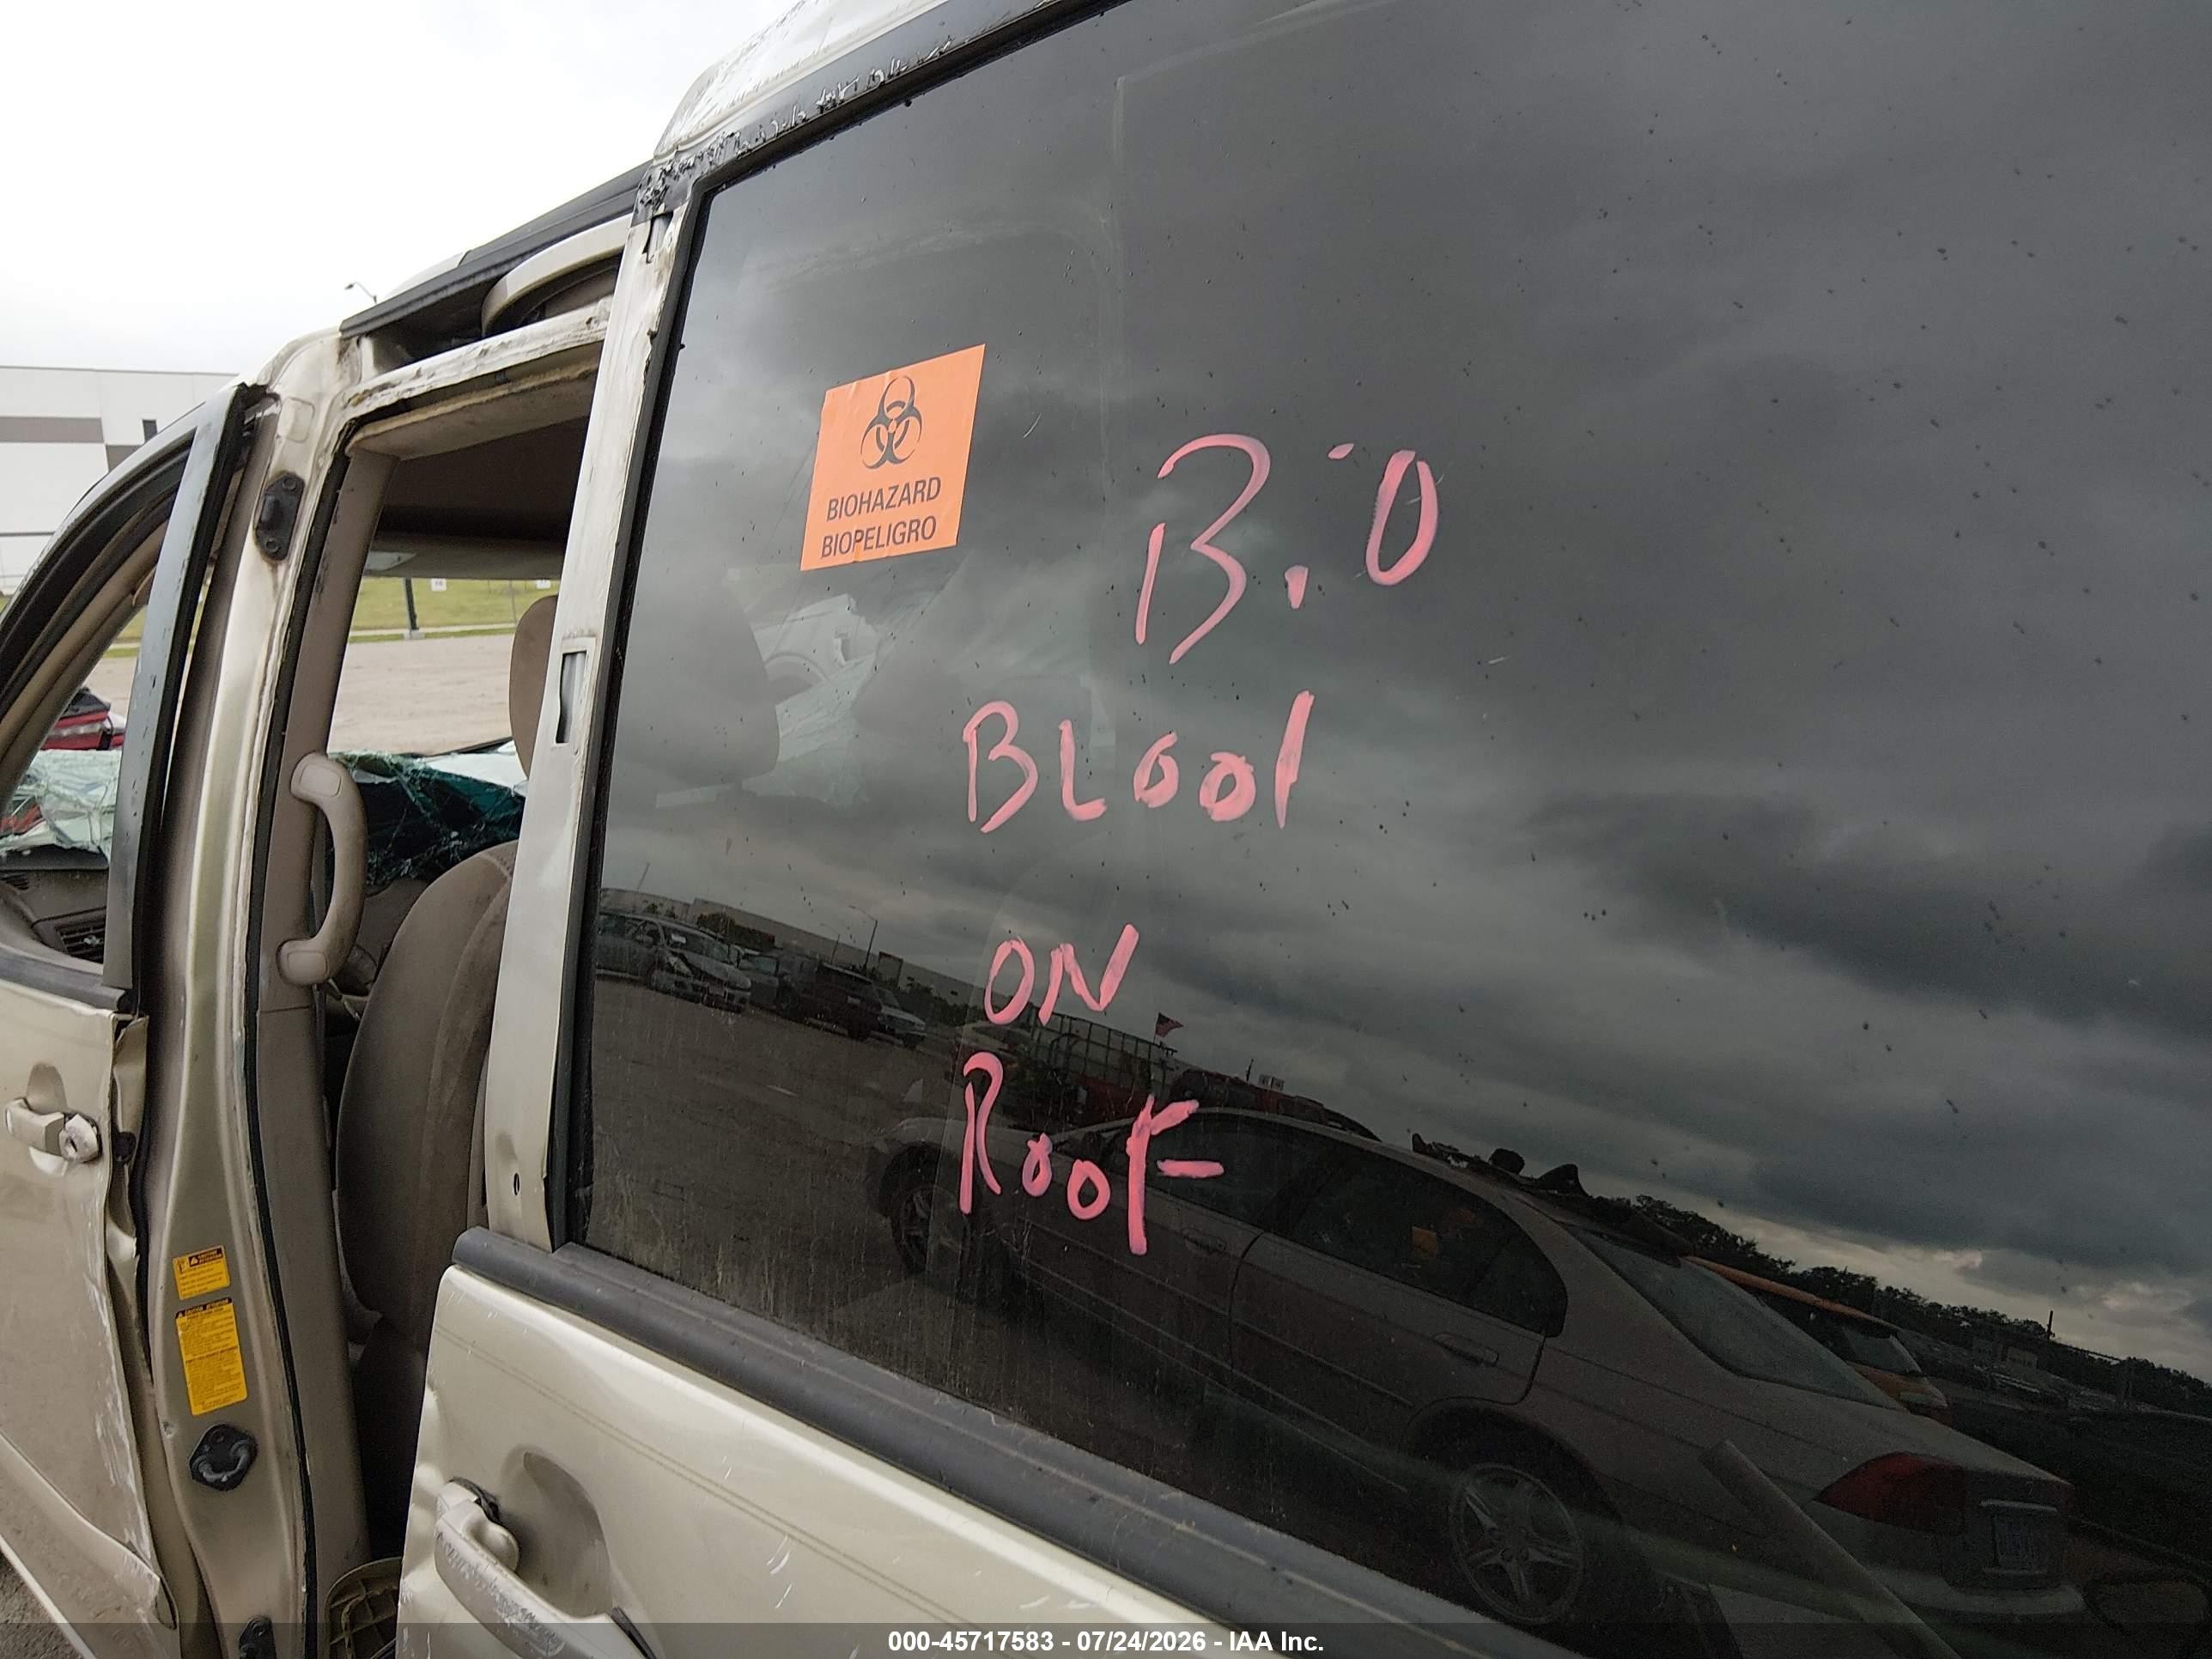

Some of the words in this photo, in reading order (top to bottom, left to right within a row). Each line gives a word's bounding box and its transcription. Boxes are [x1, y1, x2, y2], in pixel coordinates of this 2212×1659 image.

[826, 477, 941, 522] BIOHAZARD
[821, 515, 937, 558] BIOPELIGRO
[984, 923, 1139, 1025] ON
